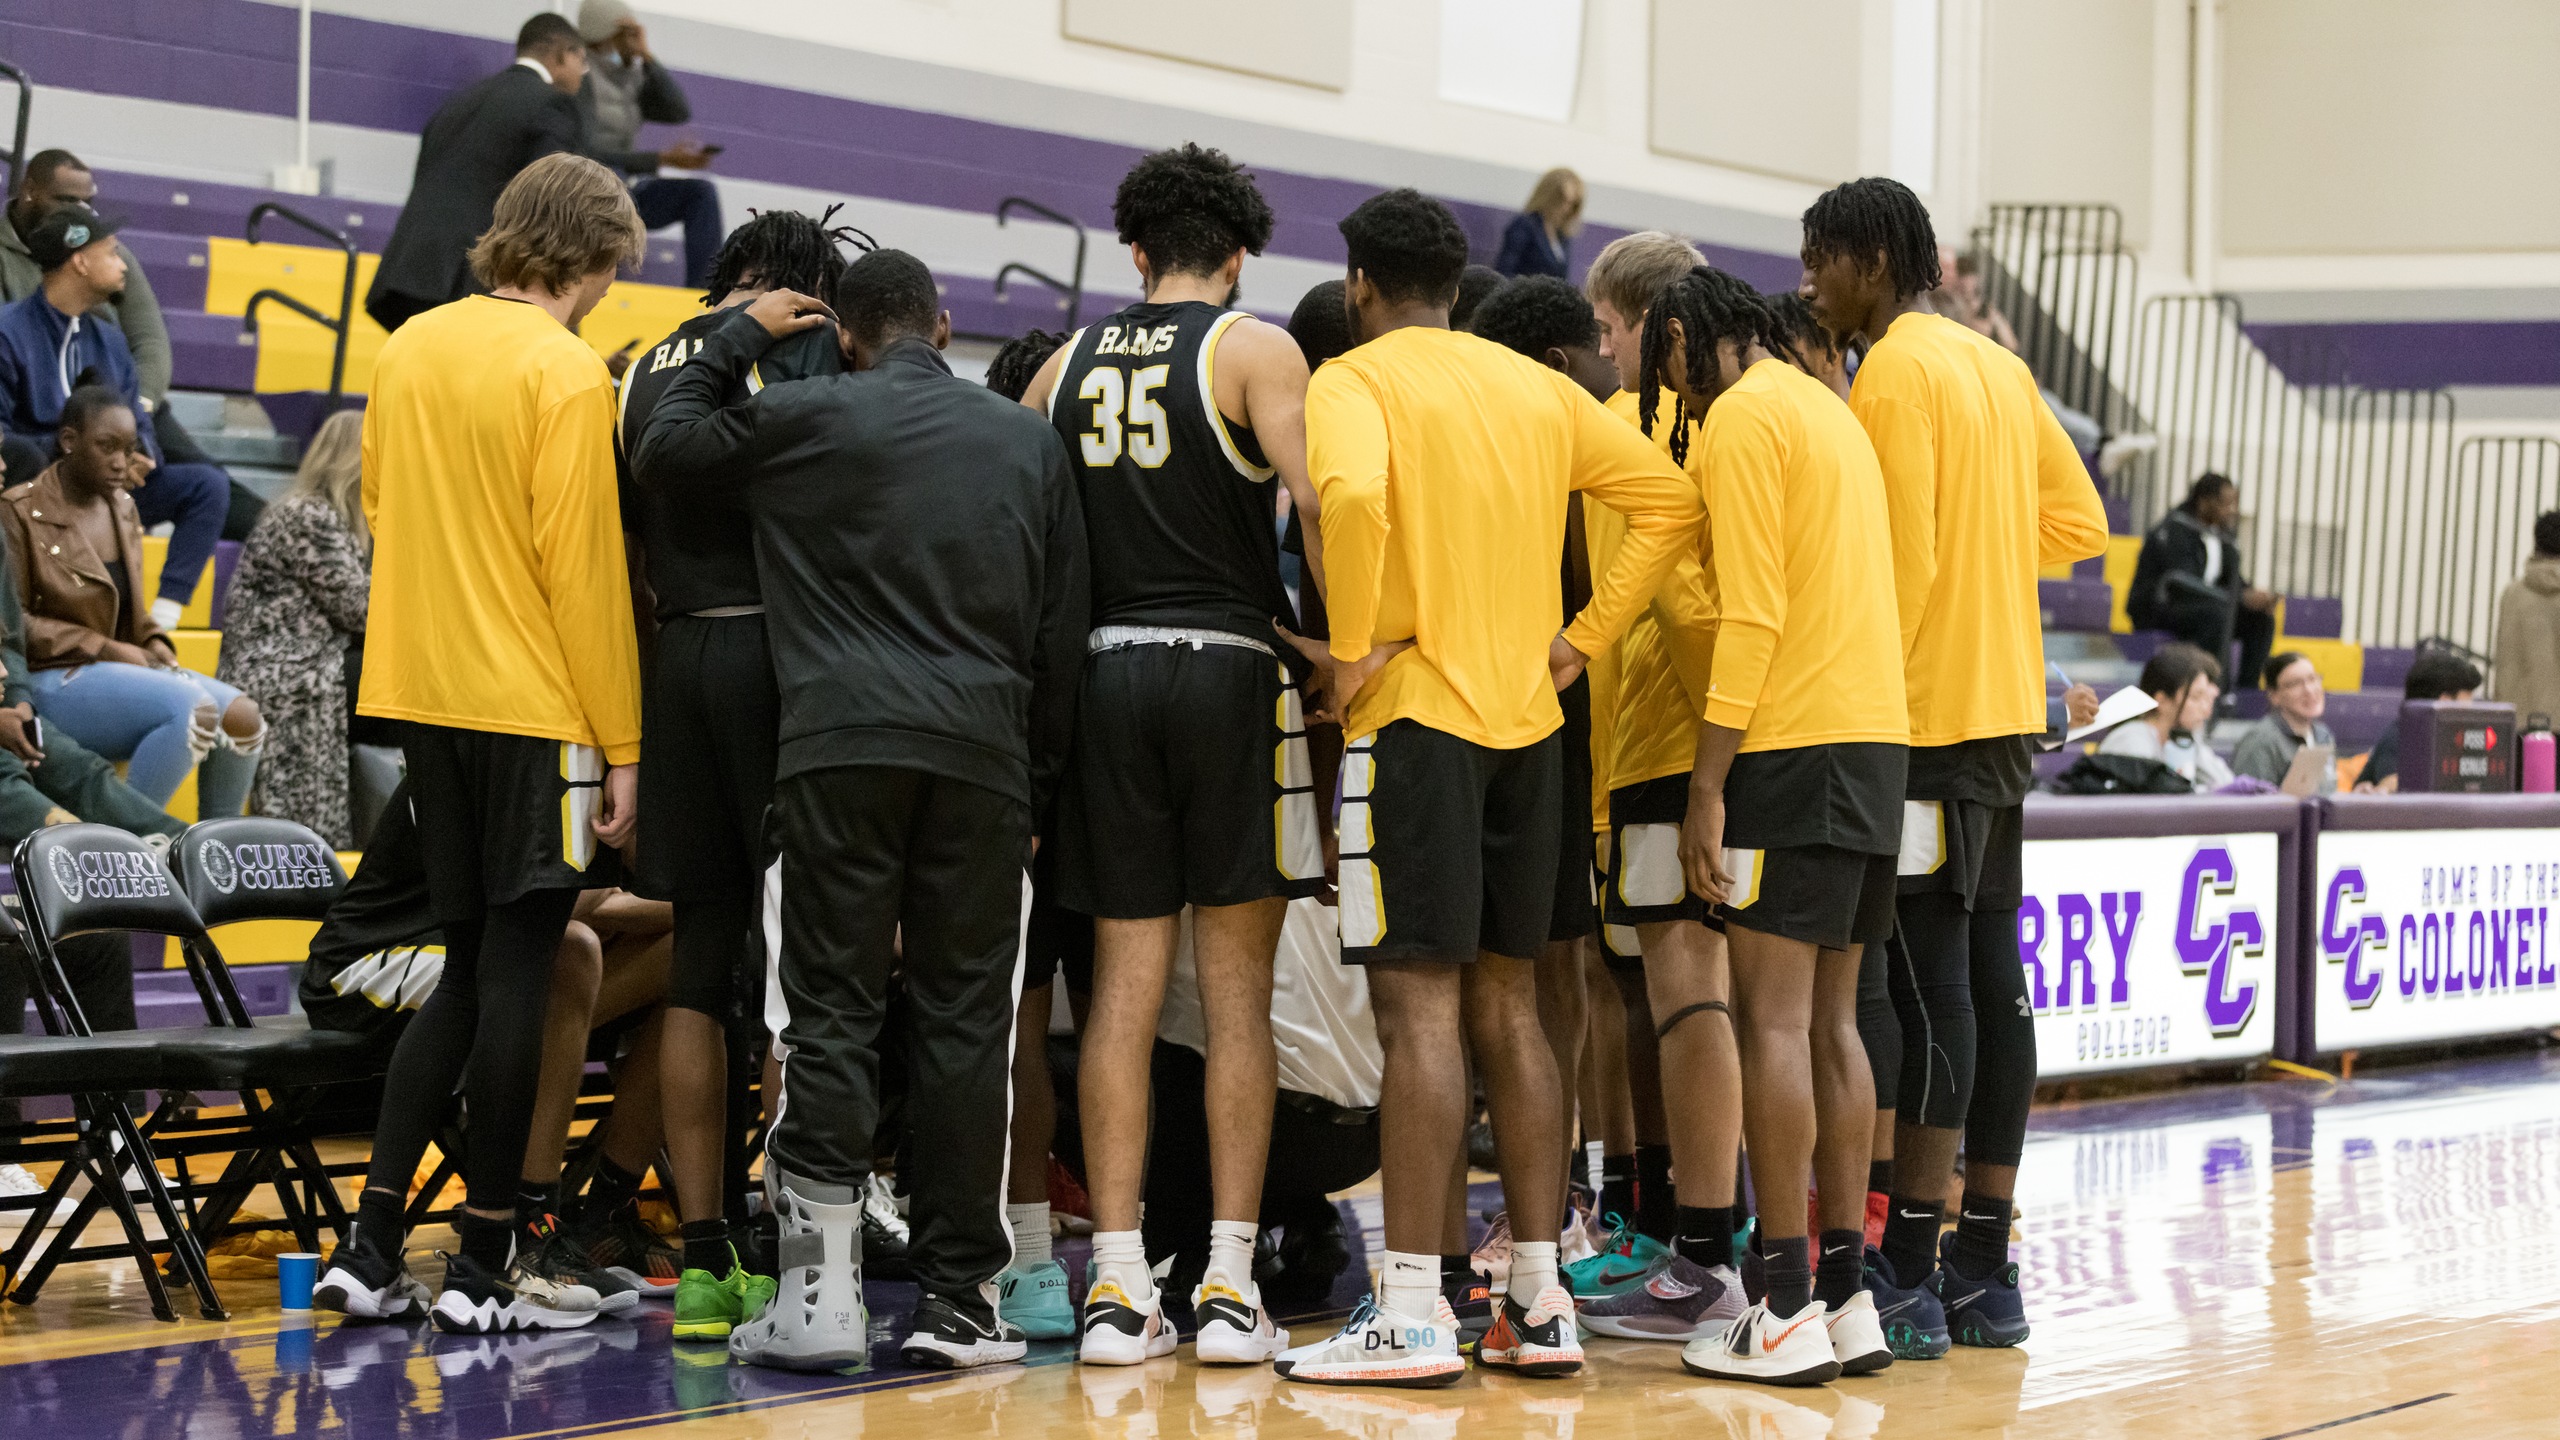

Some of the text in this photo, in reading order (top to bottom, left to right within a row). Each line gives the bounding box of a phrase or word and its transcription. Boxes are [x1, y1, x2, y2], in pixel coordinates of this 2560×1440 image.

[1095, 324, 1178, 356] RAMS
[1078, 364, 1171, 469] 35
[79, 850, 162, 878] CURRY
[235, 843, 327, 870] CURRY
[86, 876, 170, 898] COLLEGE
[241, 868, 334, 890] COLLEGE
[2421, 861, 2560, 906] HOME OF THE
